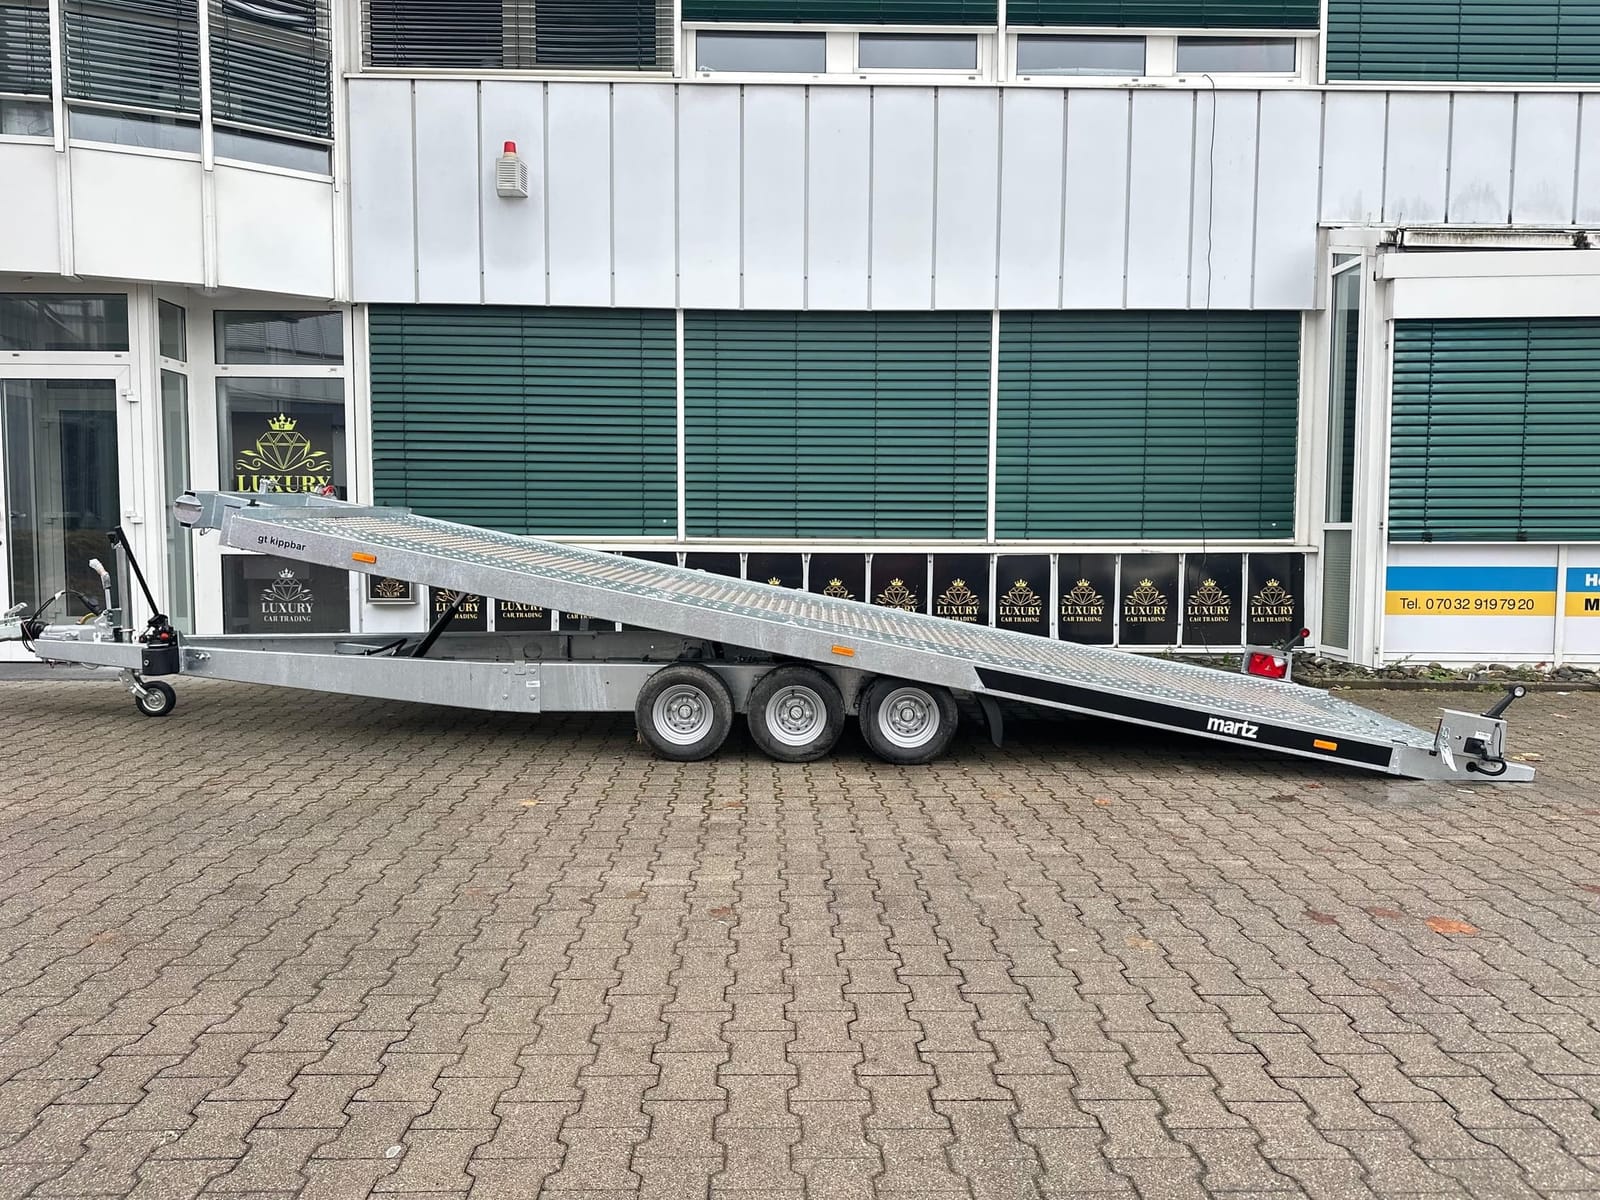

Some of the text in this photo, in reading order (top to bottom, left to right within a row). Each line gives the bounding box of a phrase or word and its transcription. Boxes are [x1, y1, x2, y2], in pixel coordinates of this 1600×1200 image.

[257, 535, 306, 551] gt kippbar
[1585, 573, 1600, 587] H
[262, 602, 313, 613] LUXURY
[436, 602, 480, 612] LUURY
[1400, 597, 1421, 610] Tel.
[937, 605, 980, 615] LUXURY
[1000, 606, 1042, 616] LUXURY
[1061, 605, 1104, 616] LUXURY
[1124, 606, 1167, 616] LUXURY
[1188, 605, 1231, 616] LUXURY
[1251, 606, 1294, 616] LUXURY
[1207, 717, 1259, 739] martz
